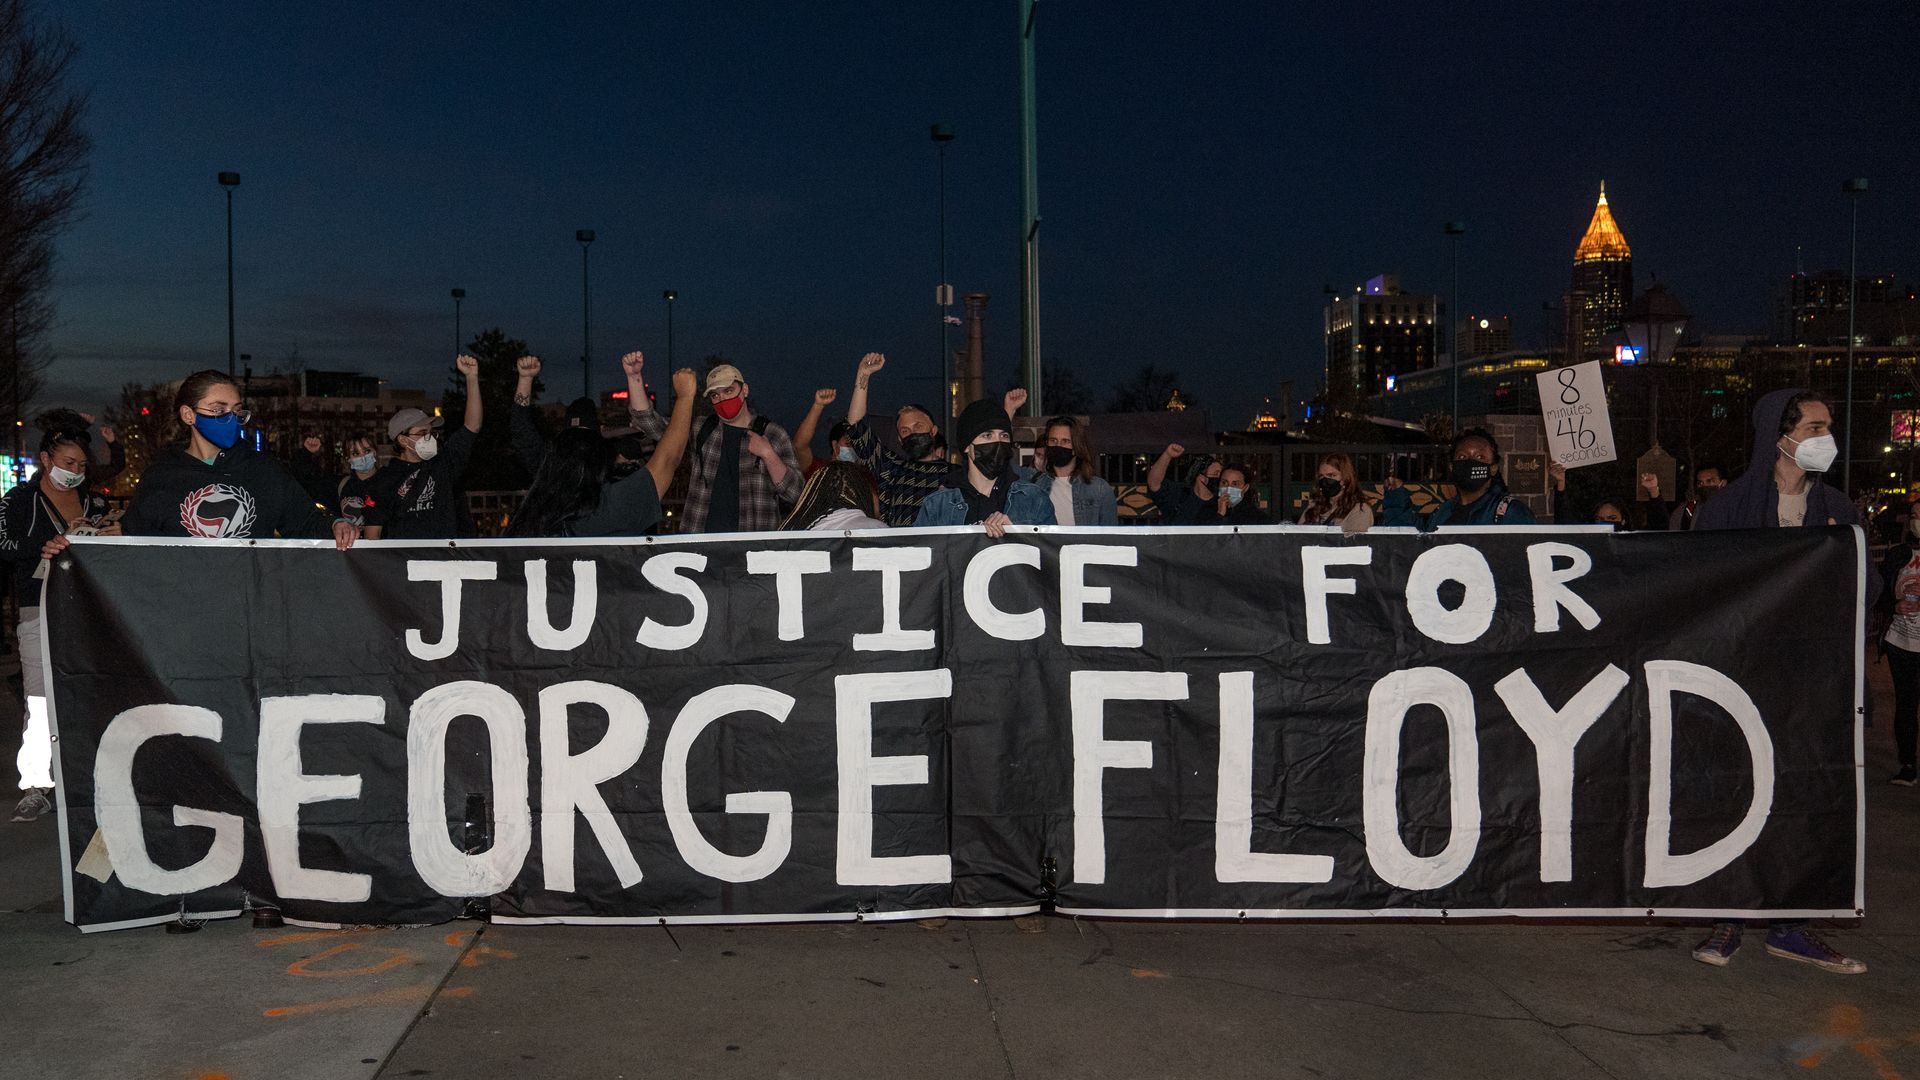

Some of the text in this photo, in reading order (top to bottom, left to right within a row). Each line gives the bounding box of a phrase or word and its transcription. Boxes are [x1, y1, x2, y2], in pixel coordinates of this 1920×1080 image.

[1557, 367, 1581, 405] 8
[1546, 402, 1593, 421] minutes
[1556, 414, 1596, 450] 46
[1560, 442, 1609, 464] seconds
[405, 541, 1602, 661] JUSTICE FOR
[93, 659, 1775, 903] GEORGE FLOYD
